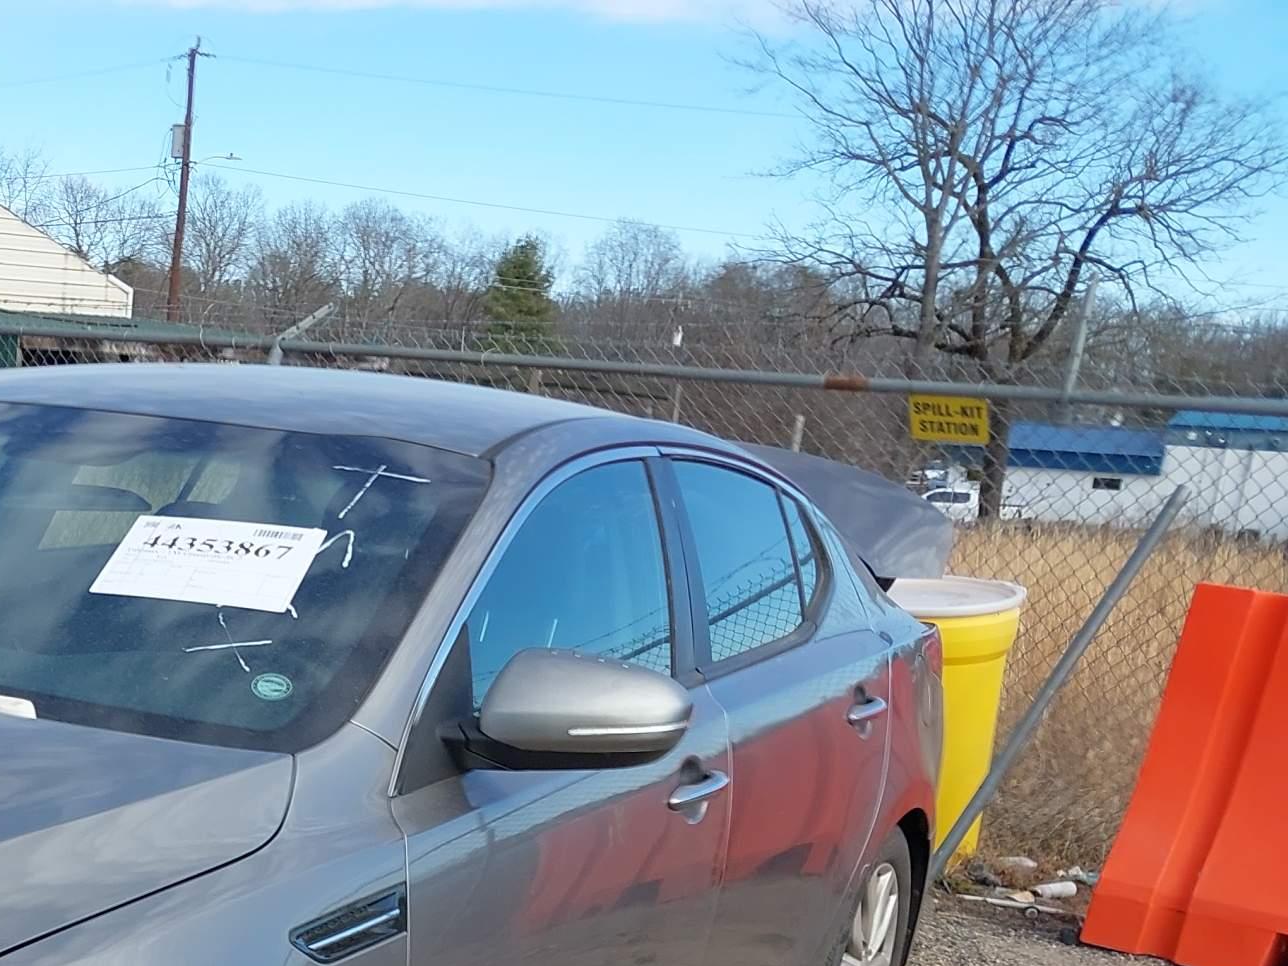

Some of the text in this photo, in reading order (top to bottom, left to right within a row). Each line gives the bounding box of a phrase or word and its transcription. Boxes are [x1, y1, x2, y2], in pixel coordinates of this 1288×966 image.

[912, 401, 984, 419] SPILL-KIT
[919, 420, 979, 436] STATION
[143, 534, 294, 560] 44353867
